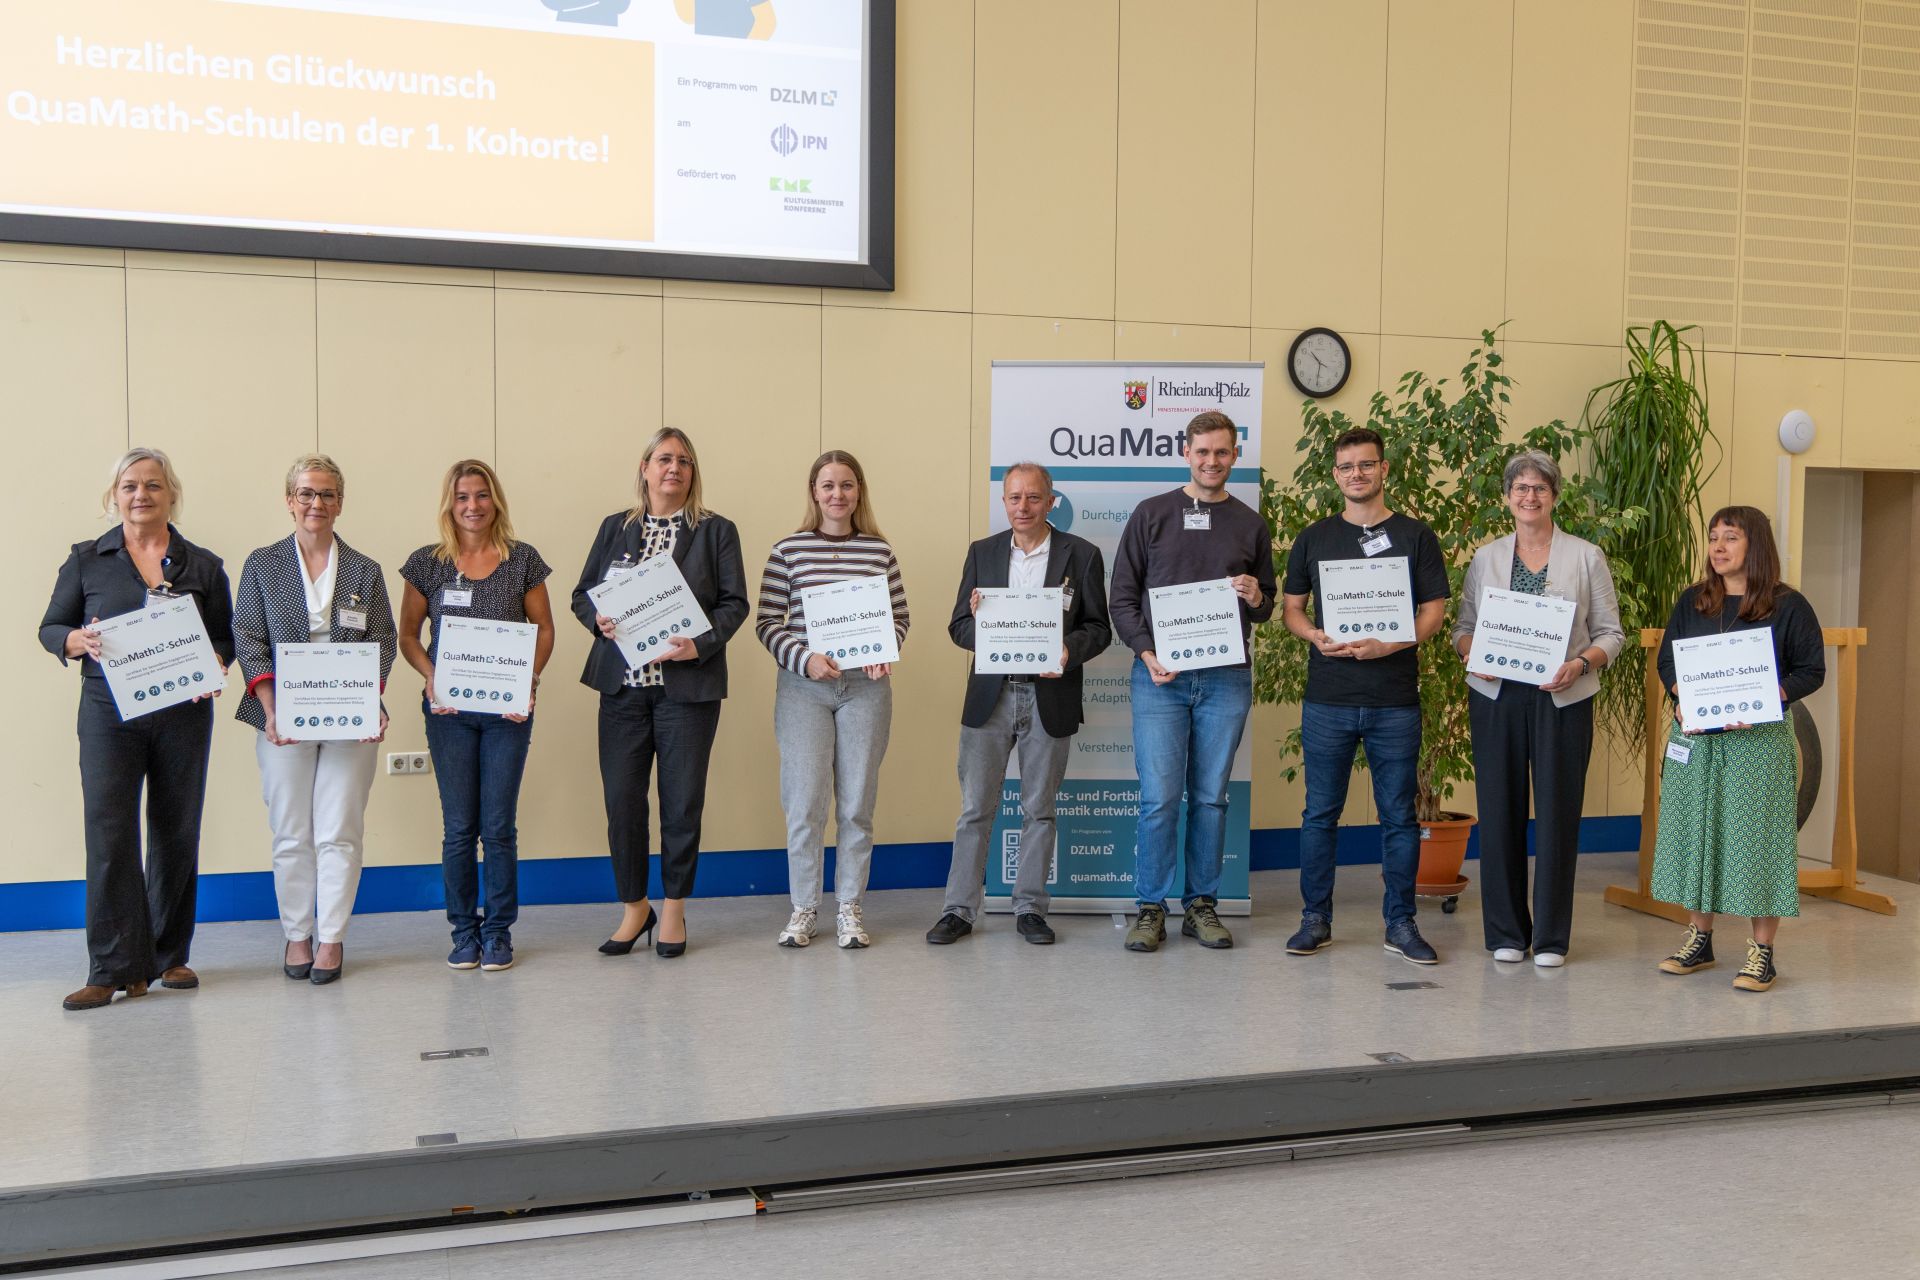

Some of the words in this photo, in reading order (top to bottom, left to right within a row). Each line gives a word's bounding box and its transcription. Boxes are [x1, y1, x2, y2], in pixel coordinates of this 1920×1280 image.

[56, 34, 254, 80] Herzlichen
[265, 52, 497, 100] Glückwunsch
[677, 77, 690, 86] Ein
[693, 78, 737, 90] Programm
[739, 84, 758, 92] vom
[770, 88, 817, 105] DZLM
[8, 90, 346, 144] QuaMath-Schulen
[356, 116, 415, 149] der
[425, 123, 455, 152] 1.
[466, 125, 611, 163] Kohorte!
[802, 135, 828, 150] IPN
[677, 168, 718, 180] Gefördert
[720, 173, 736, 181] von
[784, 197, 844, 207] KULTUSMINISTER
[784, 205, 827, 214] KONFERENZ
[1050, 427, 1187, 459] QuaMat
[1082, 509, 1131, 523] Durchgä
[1076, 791, 1100, 801] und
[1003, 805, 1014, 816] in
[1070, 845, 1101, 855] DZLM
[1070, 872, 1133, 883] quamath.de
